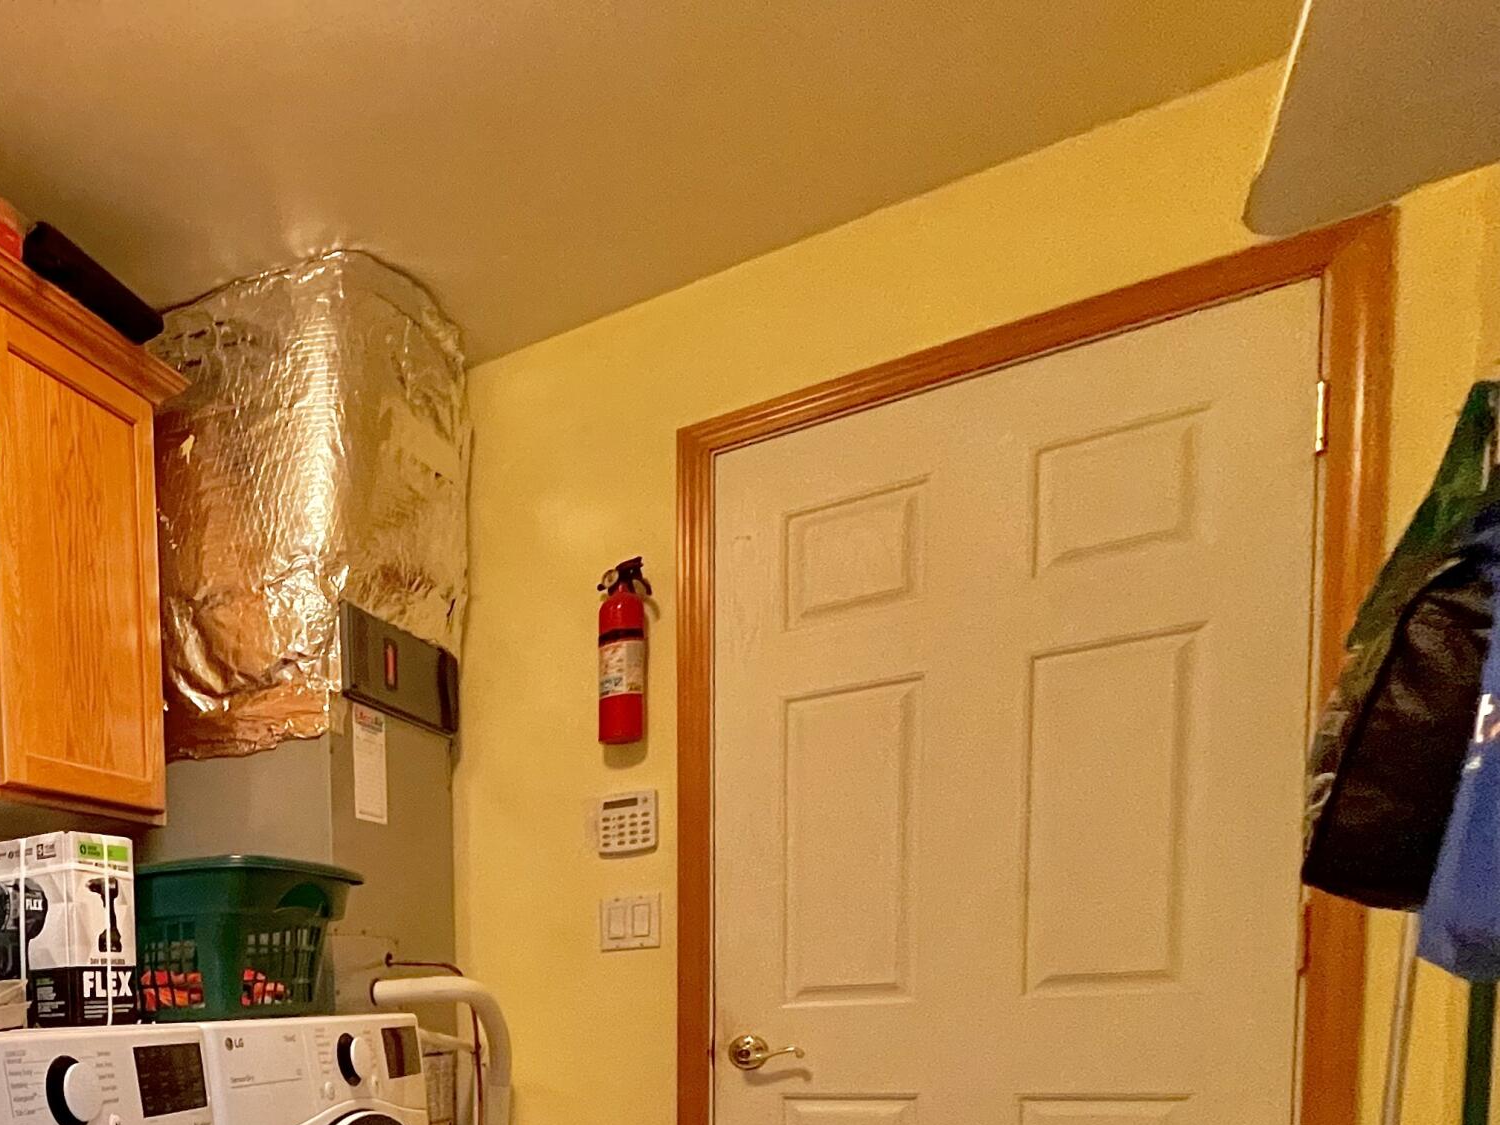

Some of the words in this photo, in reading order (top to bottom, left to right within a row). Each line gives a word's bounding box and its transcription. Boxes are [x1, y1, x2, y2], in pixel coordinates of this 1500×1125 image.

[25, 898, 43, 910] FLEX
[83, 970, 133, 998] FLEX
[234, 1037, 244, 1048] LG
